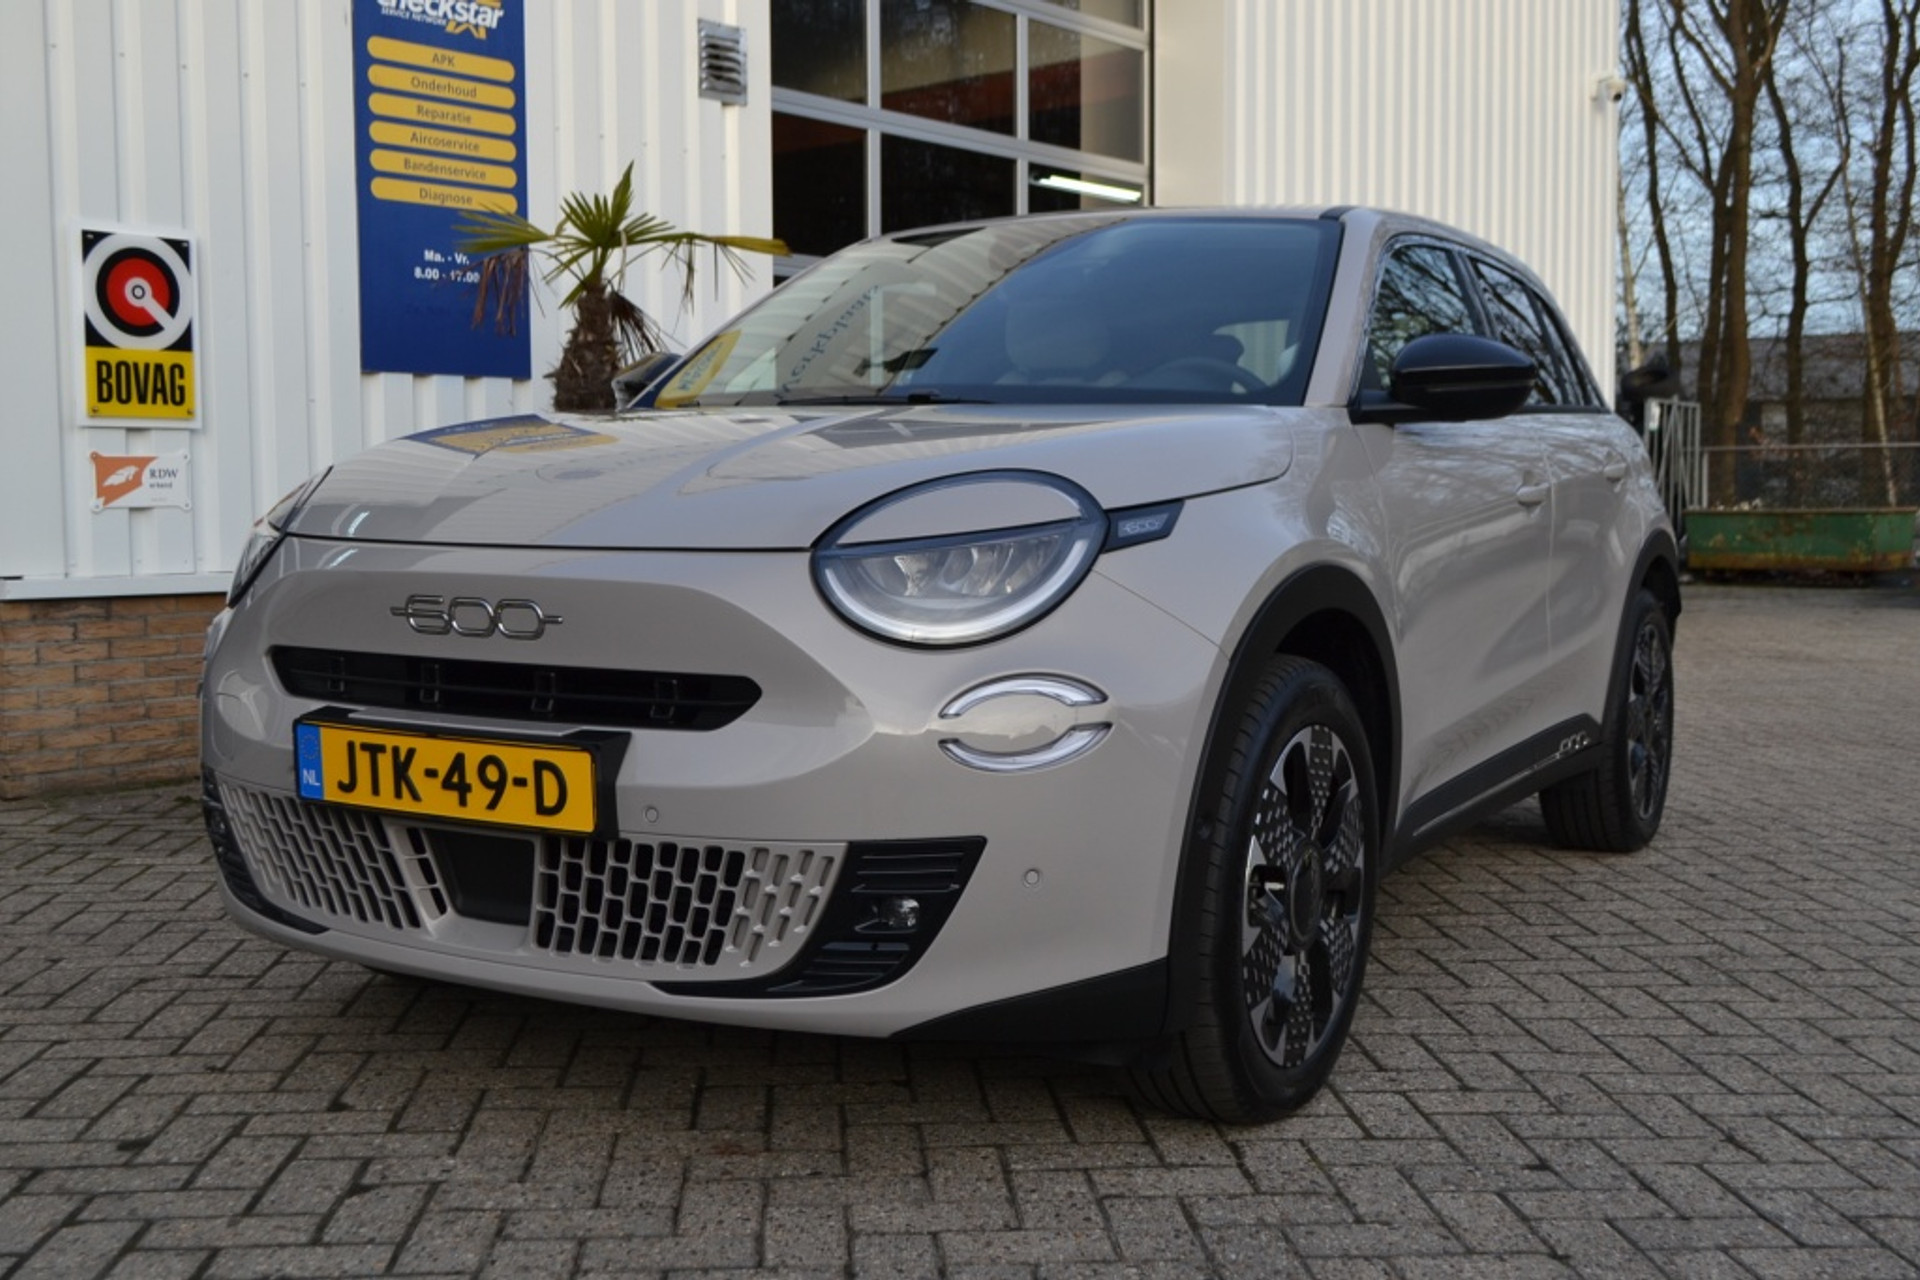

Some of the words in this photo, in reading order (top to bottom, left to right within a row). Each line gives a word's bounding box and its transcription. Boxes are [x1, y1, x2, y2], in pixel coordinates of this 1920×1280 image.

[432, 53, 455, 67] APK
[411, 76, 477, 98] Onderhoud
[416, 105, 472, 124] Reparatie
[410, 132, 480, 152] Aircoservice
[404, 158, 486, 180] Bandenservice
[419, 187, 473, 205] Diagnose
[424, 249, 445, 262] Ma.
[454, 253, 470, 264] Vr.
[414, 266, 439, 280] 8.00
[450, 270, 480, 282] 17.00
[96, 360, 186, 406] BOVAG
[149, 468, 179, 479] RDW
[392, 594, 562, 641] 600
[302, 768, 321, 788] NL
[337, 740, 568, 817] JTK-49-D
